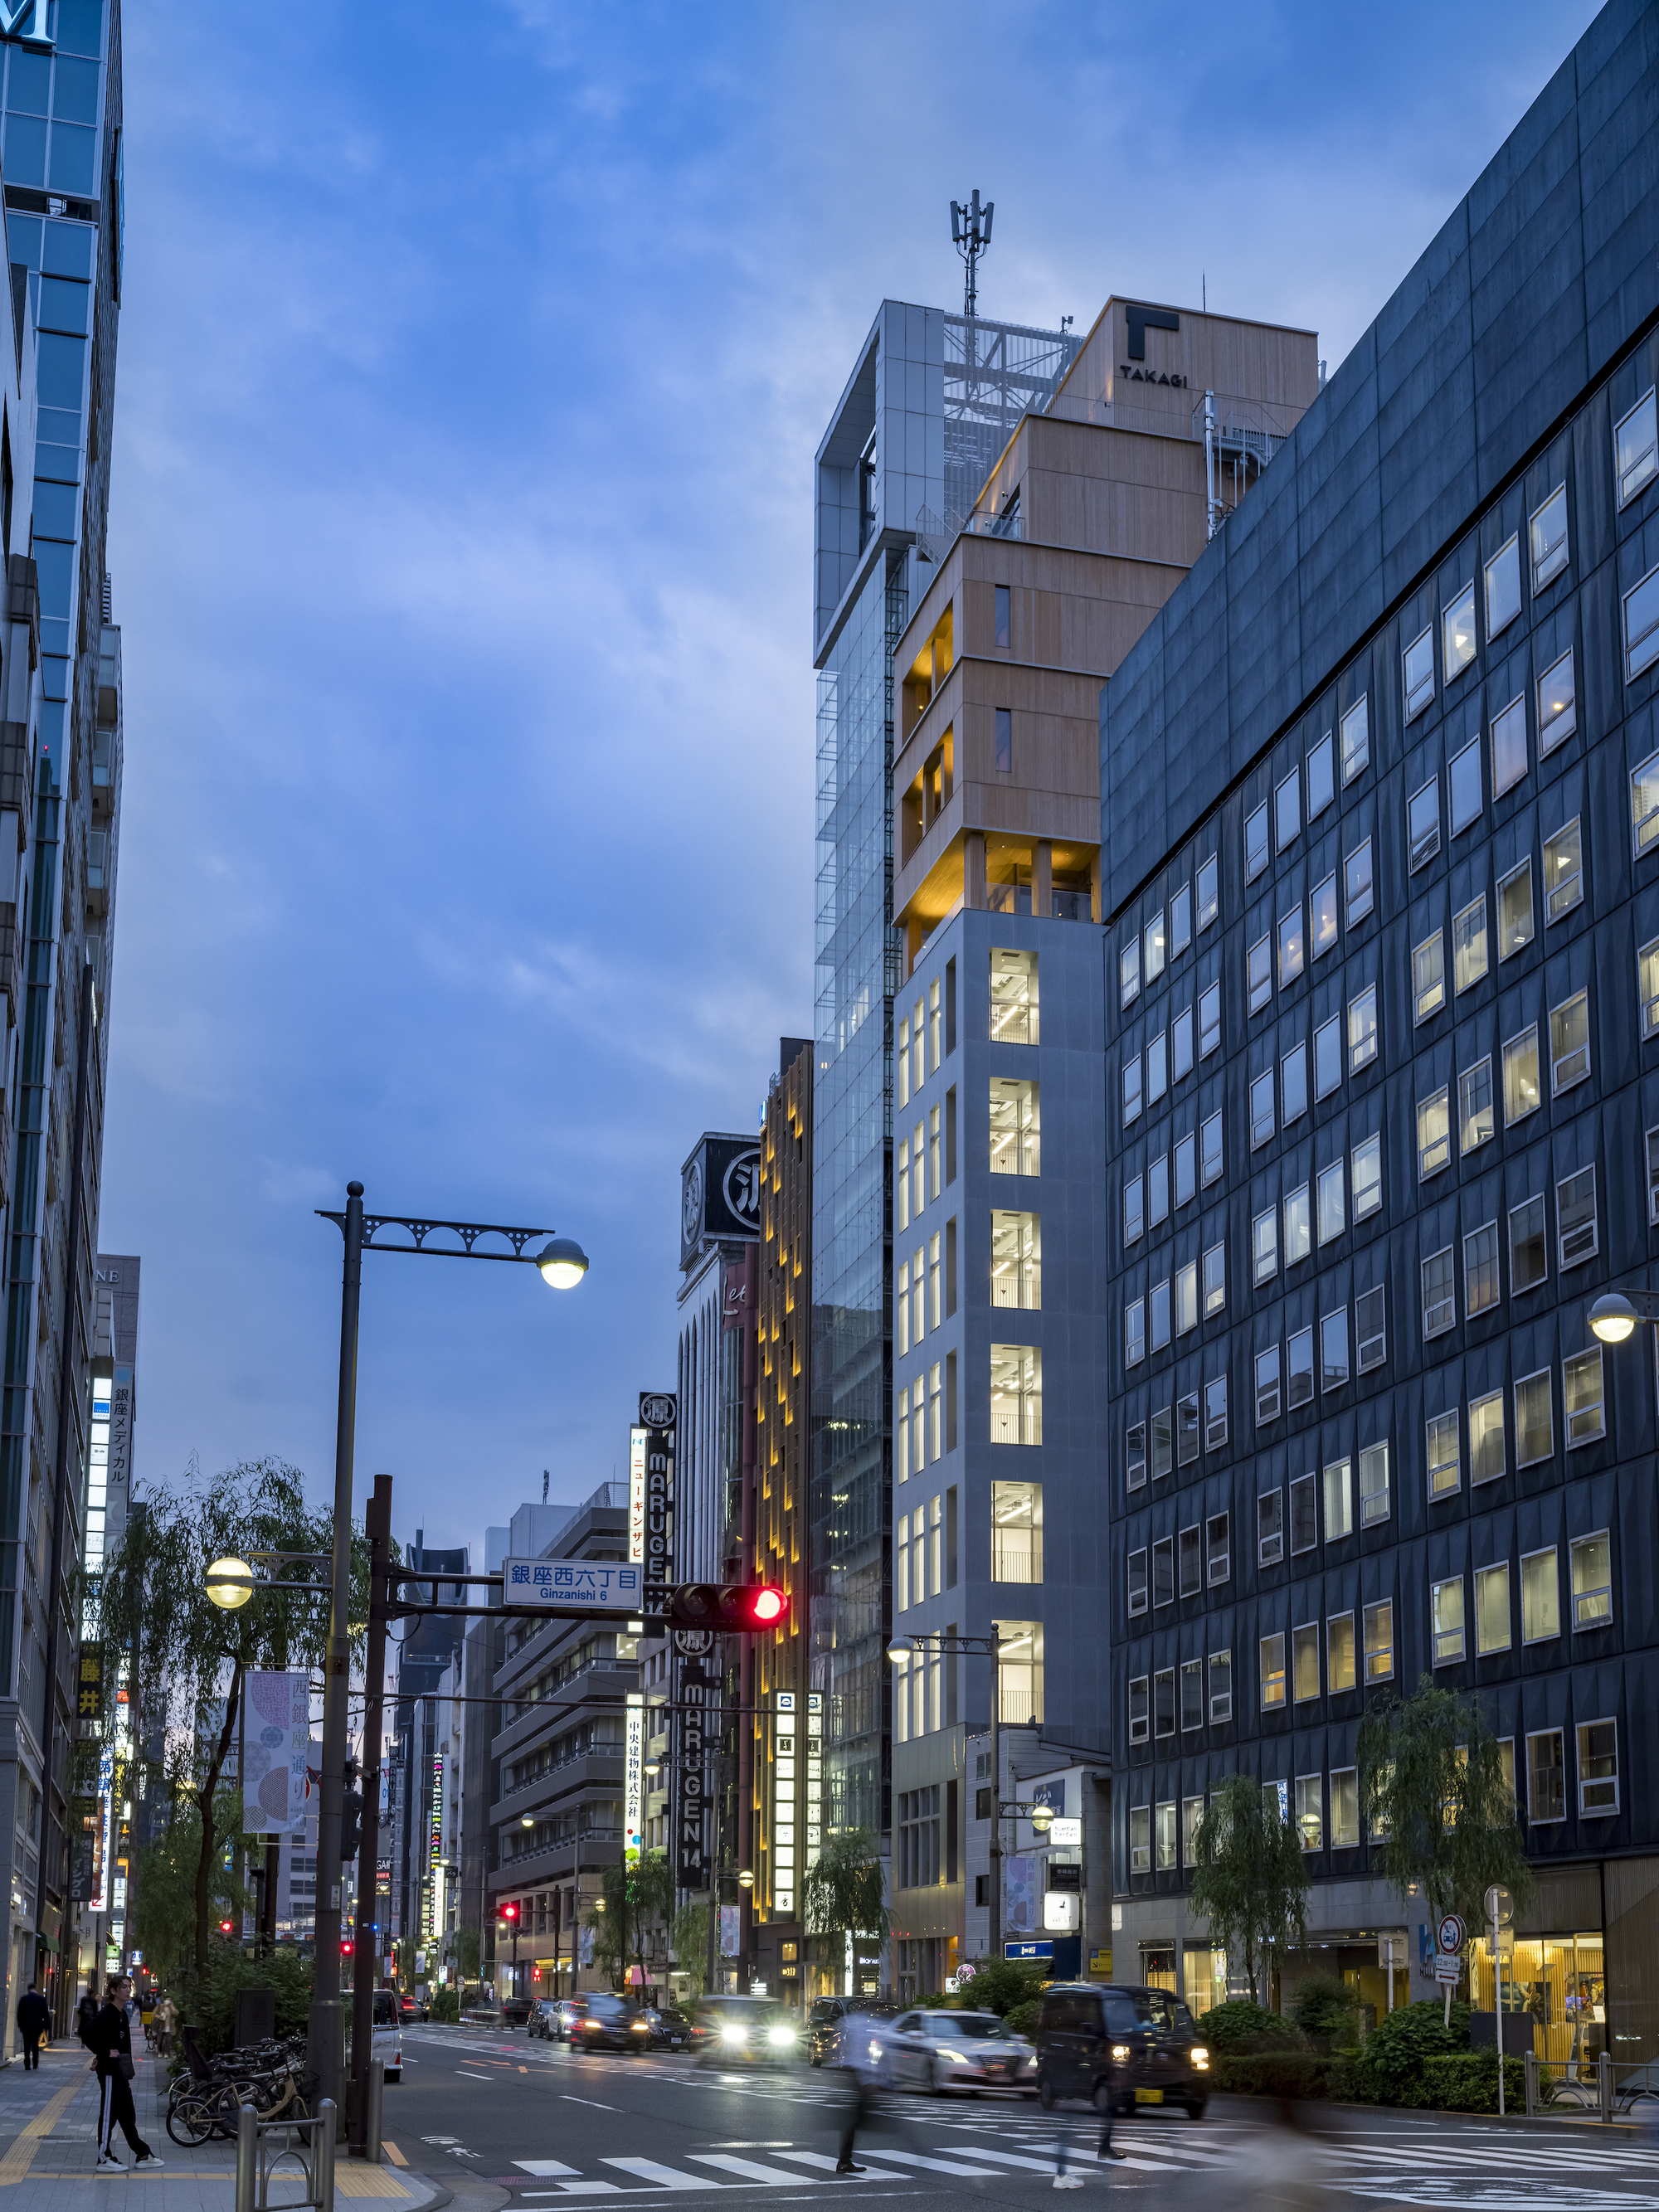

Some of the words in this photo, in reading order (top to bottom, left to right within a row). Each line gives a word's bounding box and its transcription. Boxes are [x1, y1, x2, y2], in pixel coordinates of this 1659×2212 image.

[1120, 365, 1187, 388] TAKAGI
[111, 1388, 129, 1482] 銀座メディカル
[632, 1458, 644, 1558] ニューギンザビ
[511, 1564, 636, 1589] 銀座西六丁目
[540, 1587, 596, 1601] Ginzanishi
[600, 1591, 607, 1601] 6
[80, 1659, 100, 1714] 藤井
[291, 1680, 308, 1801] 西銀座通り
[684, 1684, 703, 1842] MARUGEN
[628, 1721, 640, 1817] 中央建物株式会社
[682, 1848, 701, 1868] 14
[1437, 1957, 1459, 1968] 22:00-1:00
